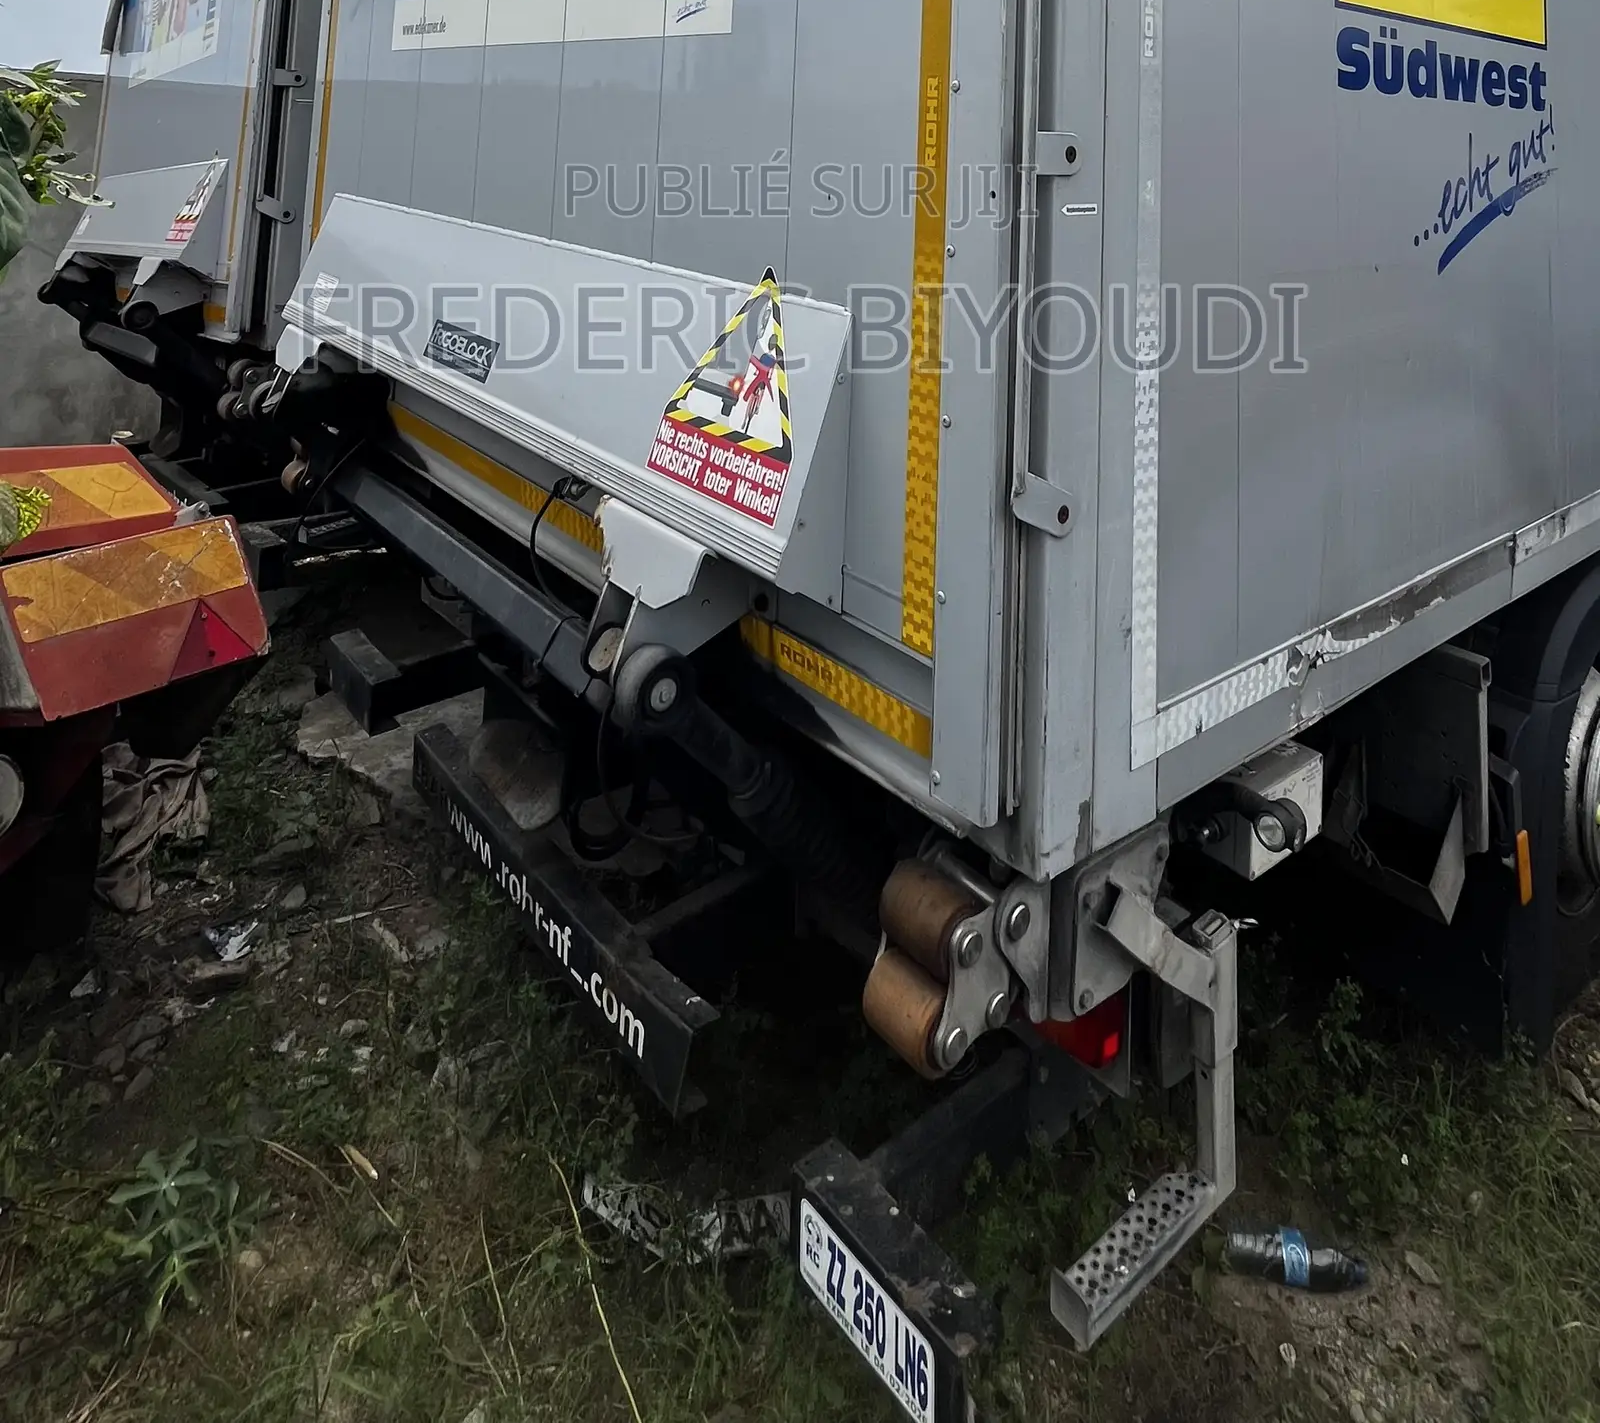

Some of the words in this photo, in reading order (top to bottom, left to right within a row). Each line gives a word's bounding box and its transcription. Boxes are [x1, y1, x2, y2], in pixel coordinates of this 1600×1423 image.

[1336, 26, 1548, 112] Südwest
[924, 77, 939, 167] ROHR
[1502, 104, 1556, 216] gut!
[651, 442, 702, 487] VORSICHT,
[703, 466, 732, 496] toter
[733, 478, 779, 518] Winkel!
[657, 419, 675, 444] Nie
[674, 431, 709, 459] rechts
[708, 444, 787, 492] vorbeifahren!
[780, 643, 834, 683] ROHR
[805, 1242, 820, 1269] RC
[826, 1236, 847, 1313] ZZ
[853, 1269, 887, 1359] 250
[894, 1314, 928, 1412] LN6
